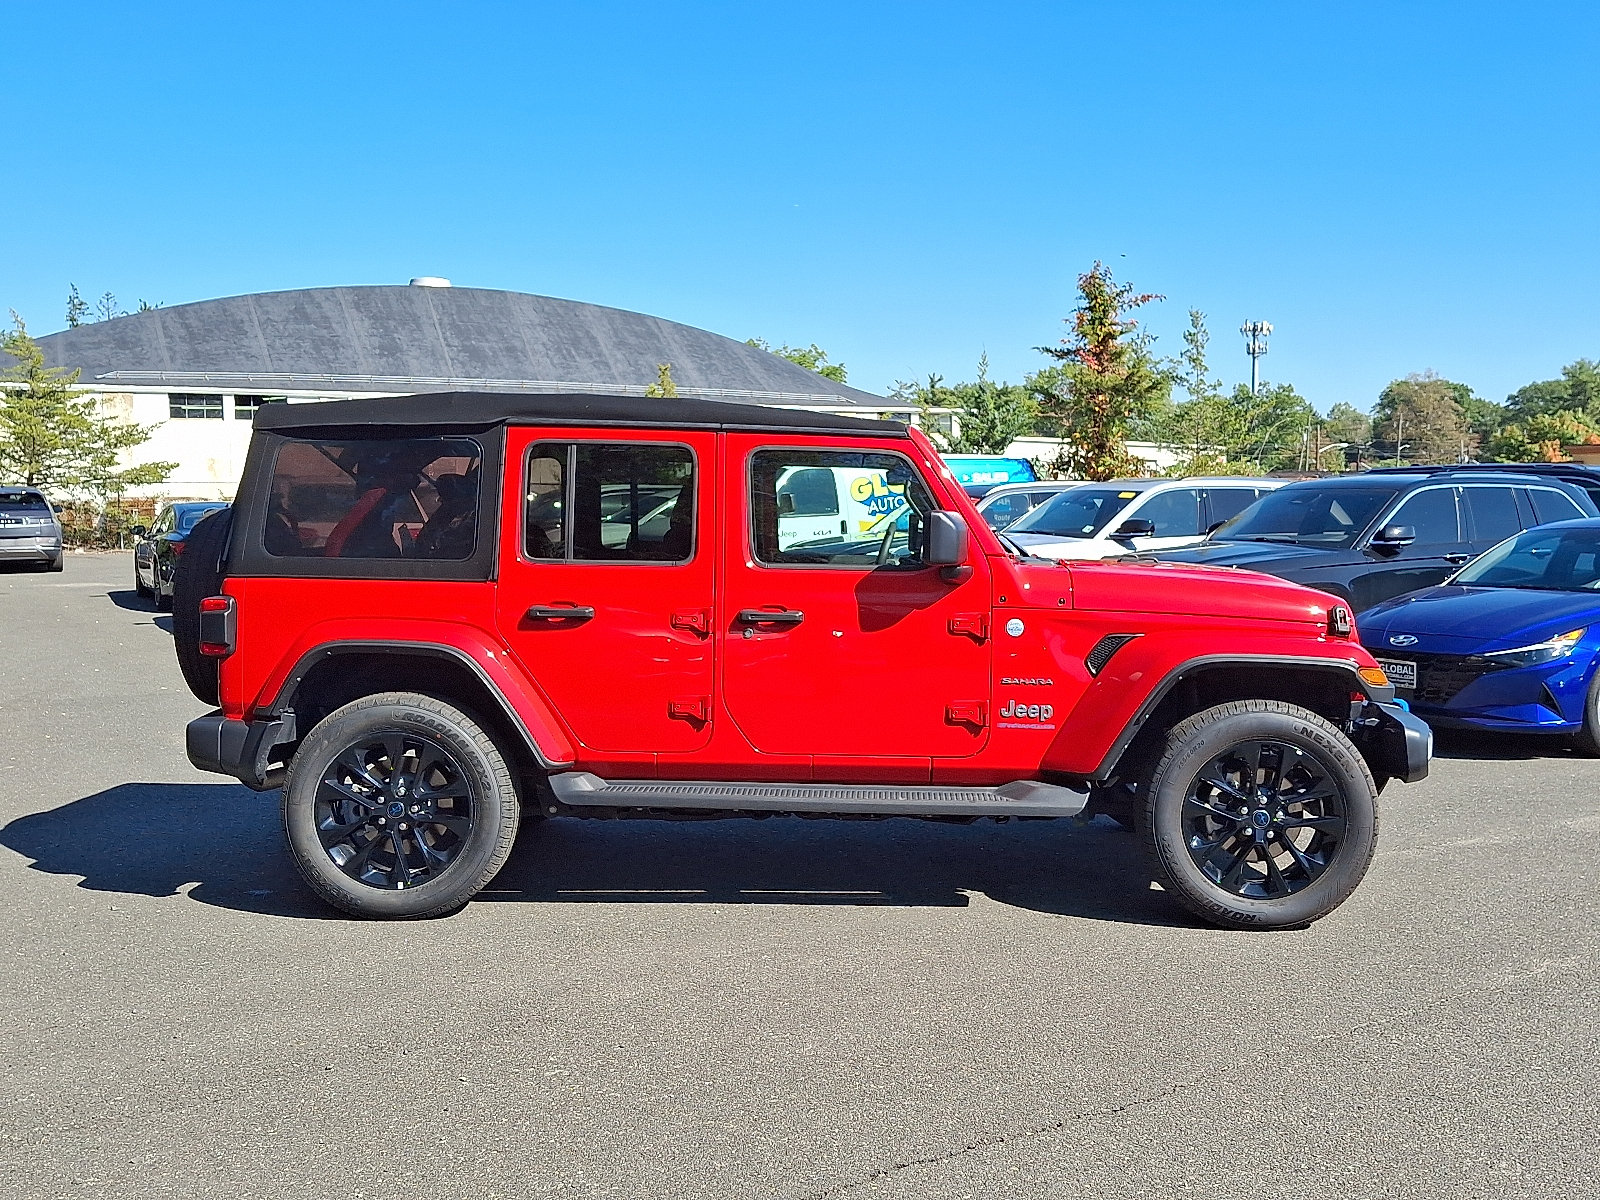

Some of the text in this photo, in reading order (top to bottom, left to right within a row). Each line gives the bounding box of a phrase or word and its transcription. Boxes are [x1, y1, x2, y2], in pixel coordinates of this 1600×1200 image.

[1000, 677, 1053, 685] SAHARA
[1000, 699, 1054, 721] Jeep
[1300, 726, 1350, 773] NEXEN
